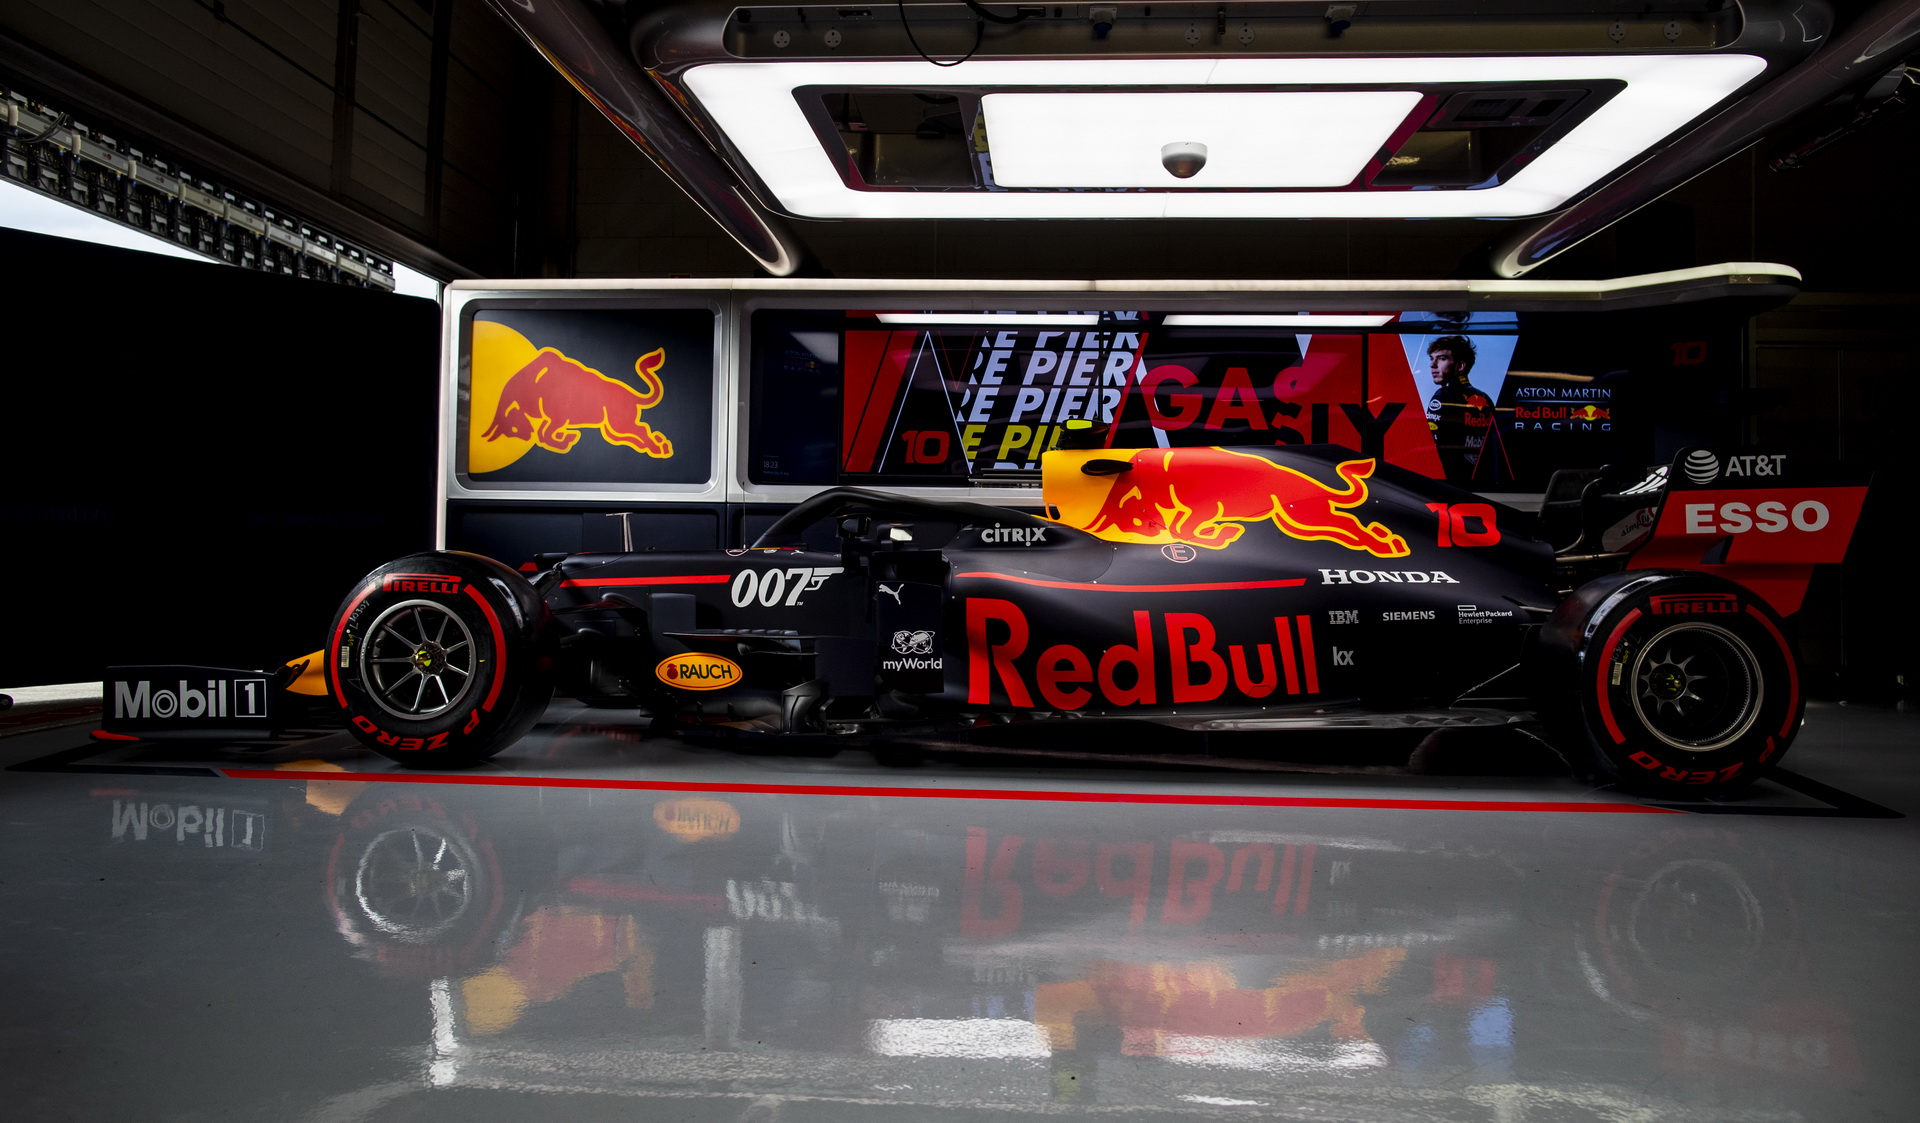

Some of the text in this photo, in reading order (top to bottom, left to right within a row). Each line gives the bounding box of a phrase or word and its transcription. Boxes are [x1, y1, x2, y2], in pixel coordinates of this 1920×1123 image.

[1669, 340, 1708, 367] 10
[1515, 387, 1612, 399] ASTON MARTIN
[1514, 422, 1611, 432] RACING
[901, 429, 950, 465] 10
[1725, 454, 1787, 477] AT&T
[1424, 503, 1502, 547] 10
[1685, 500, 1830, 534] ESSO
[1169, 545, 1188, 560] E
[381, 573, 463, 594] PIRELLI
[1318, 568, 1460, 585] HONDA
[731, 567, 814, 608] 007
[1485, 610, 1513, 618] Packard
[1649, 593, 1739, 615] PIRELLI
[1328, 610, 1360, 625] IBM
[1382, 610, 1436, 622] SIEMENS
[883, 657, 943, 672] myWorld
[1332, 646, 1355, 666] kx
[679, 663, 733, 680] RAUCH
[114, 679, 228, 718] Mobil
[351, 715, 450, 752] ZERO
[1628, 750, 1746, 785] ZERO
